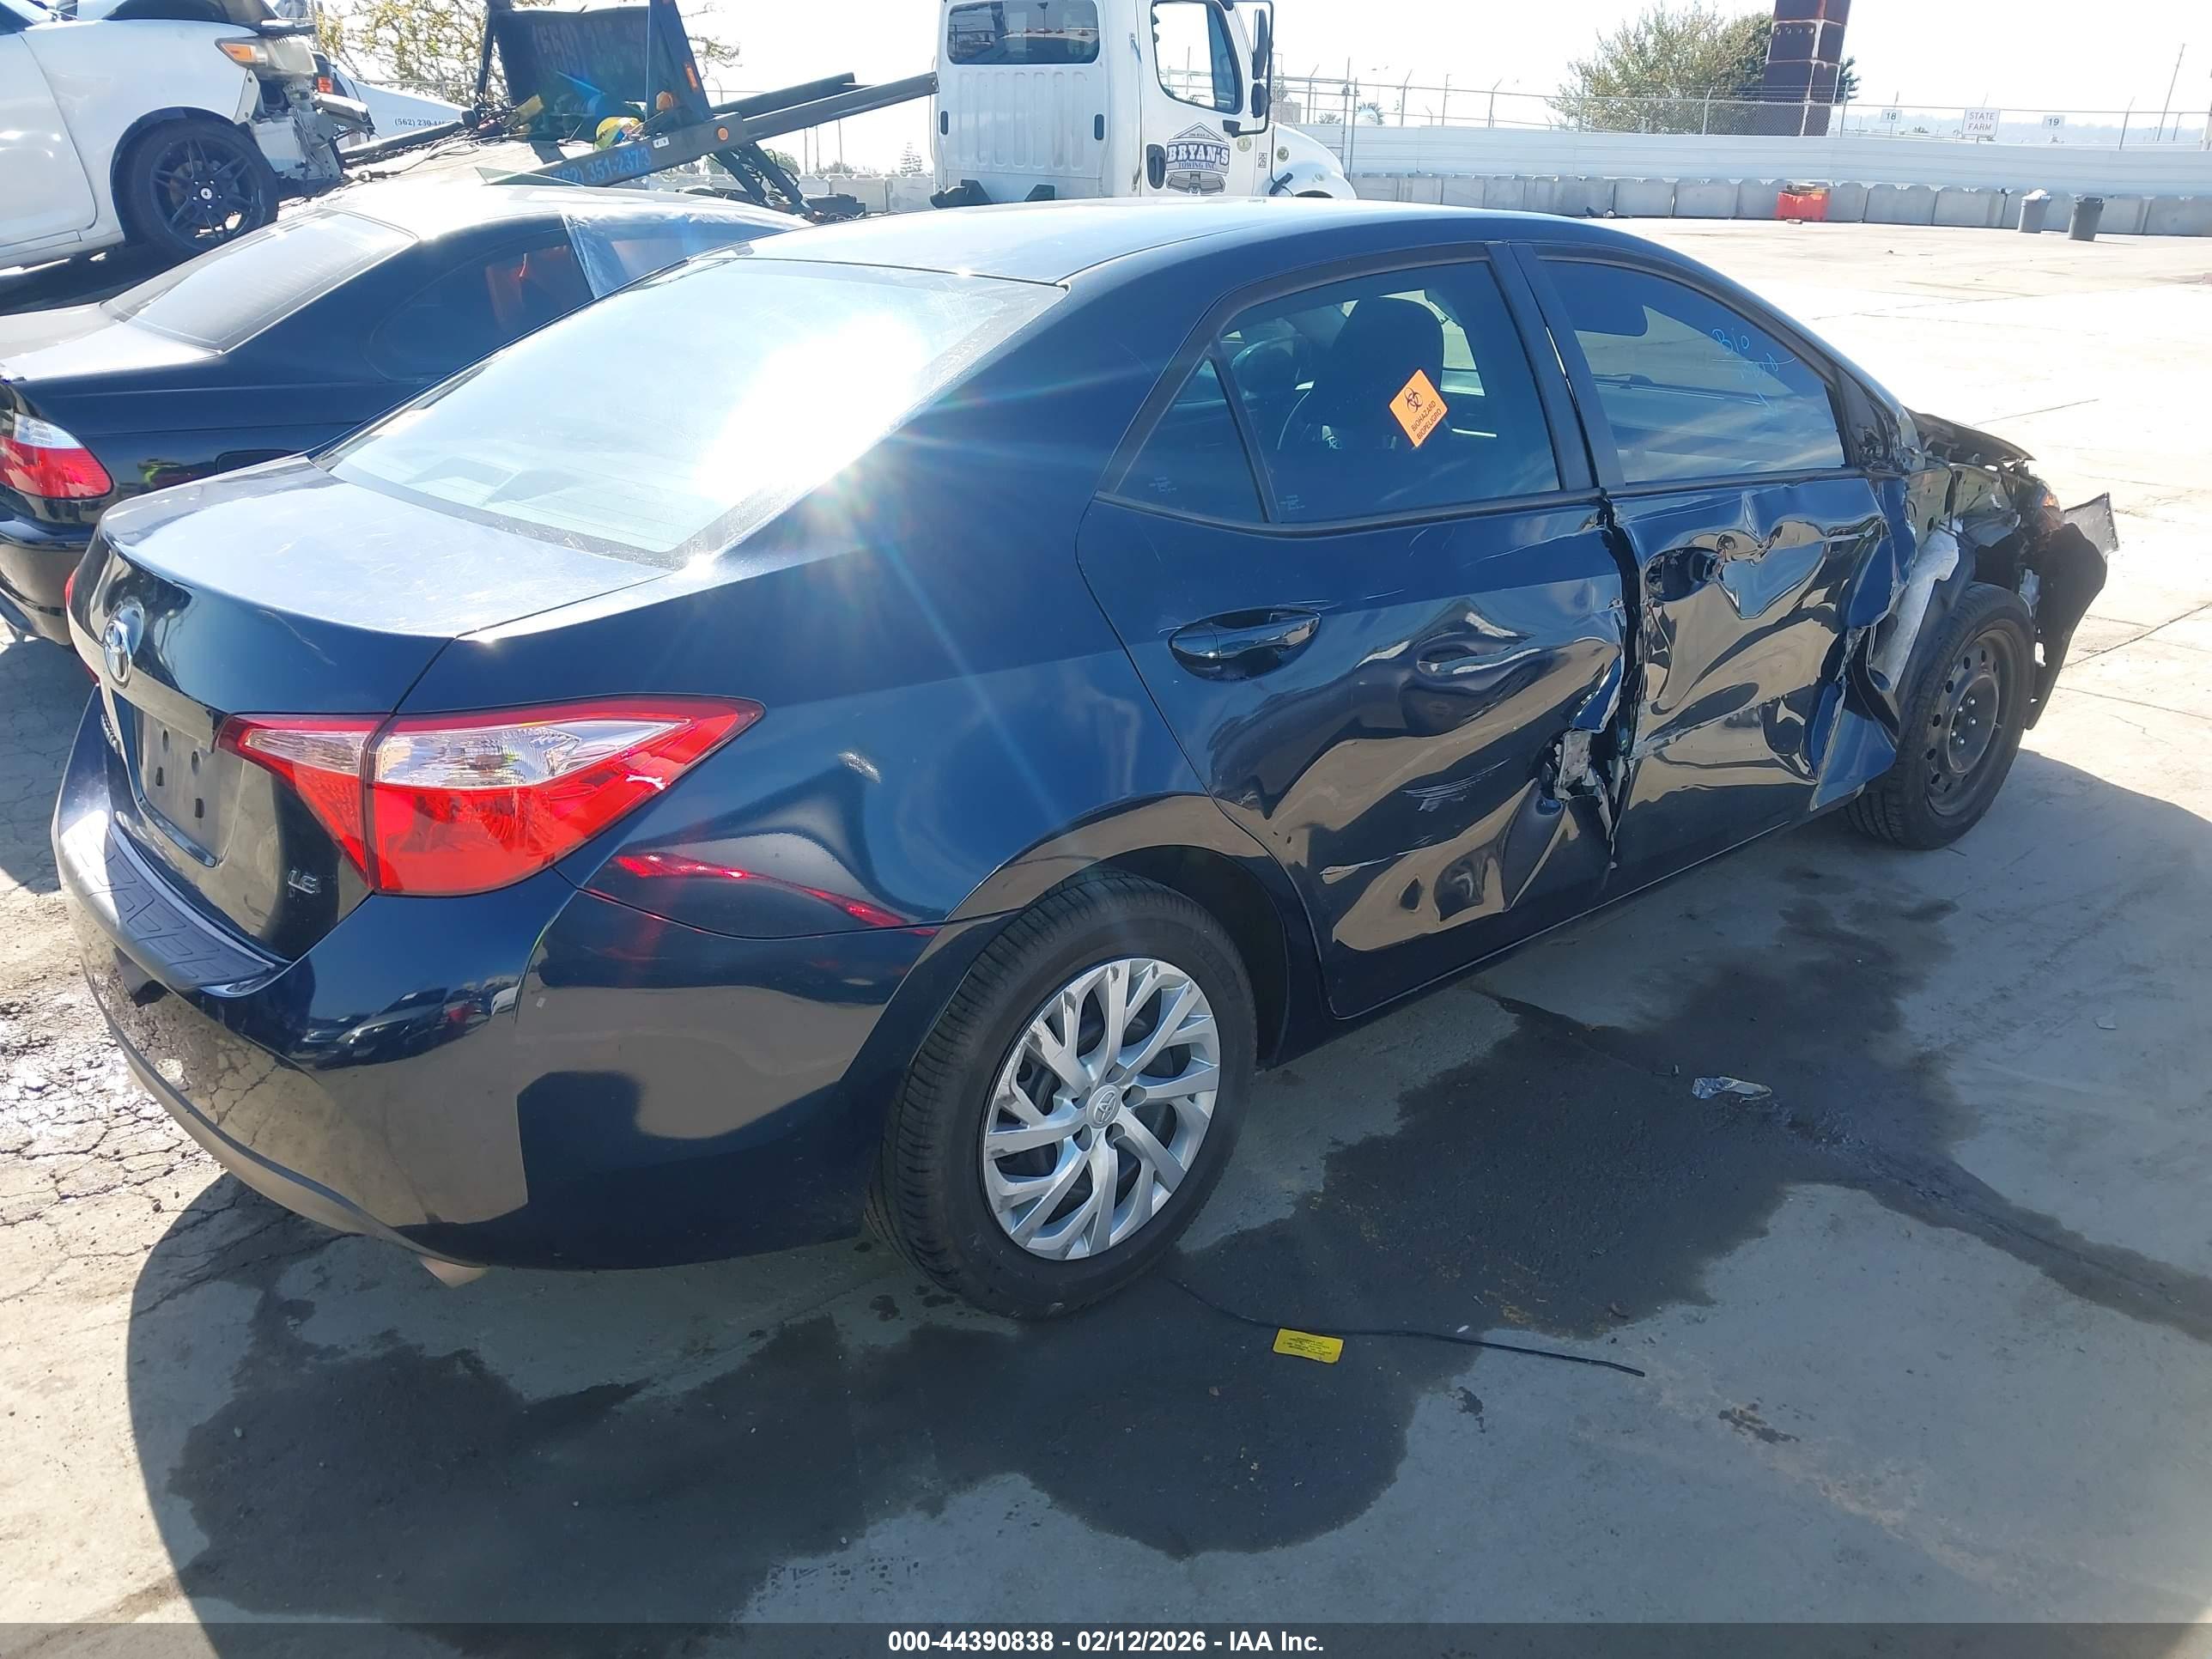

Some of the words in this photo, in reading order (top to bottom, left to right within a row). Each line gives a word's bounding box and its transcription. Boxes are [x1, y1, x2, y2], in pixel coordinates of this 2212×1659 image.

[395, 118, 416, 127] (562)
[1967, 123, 1992, 131] FARM
[1969, 112, 1995, 120] STATE
[586, 146, 652, 182] 351-2373
[1167, 143, 1231, 166] BRYAN'S
[1411, 400, 1437, 432] BIOHAZARD
[1416, 408, 1443, 440] BIOPELIGRO
[288, 869, 317, 894] LE
